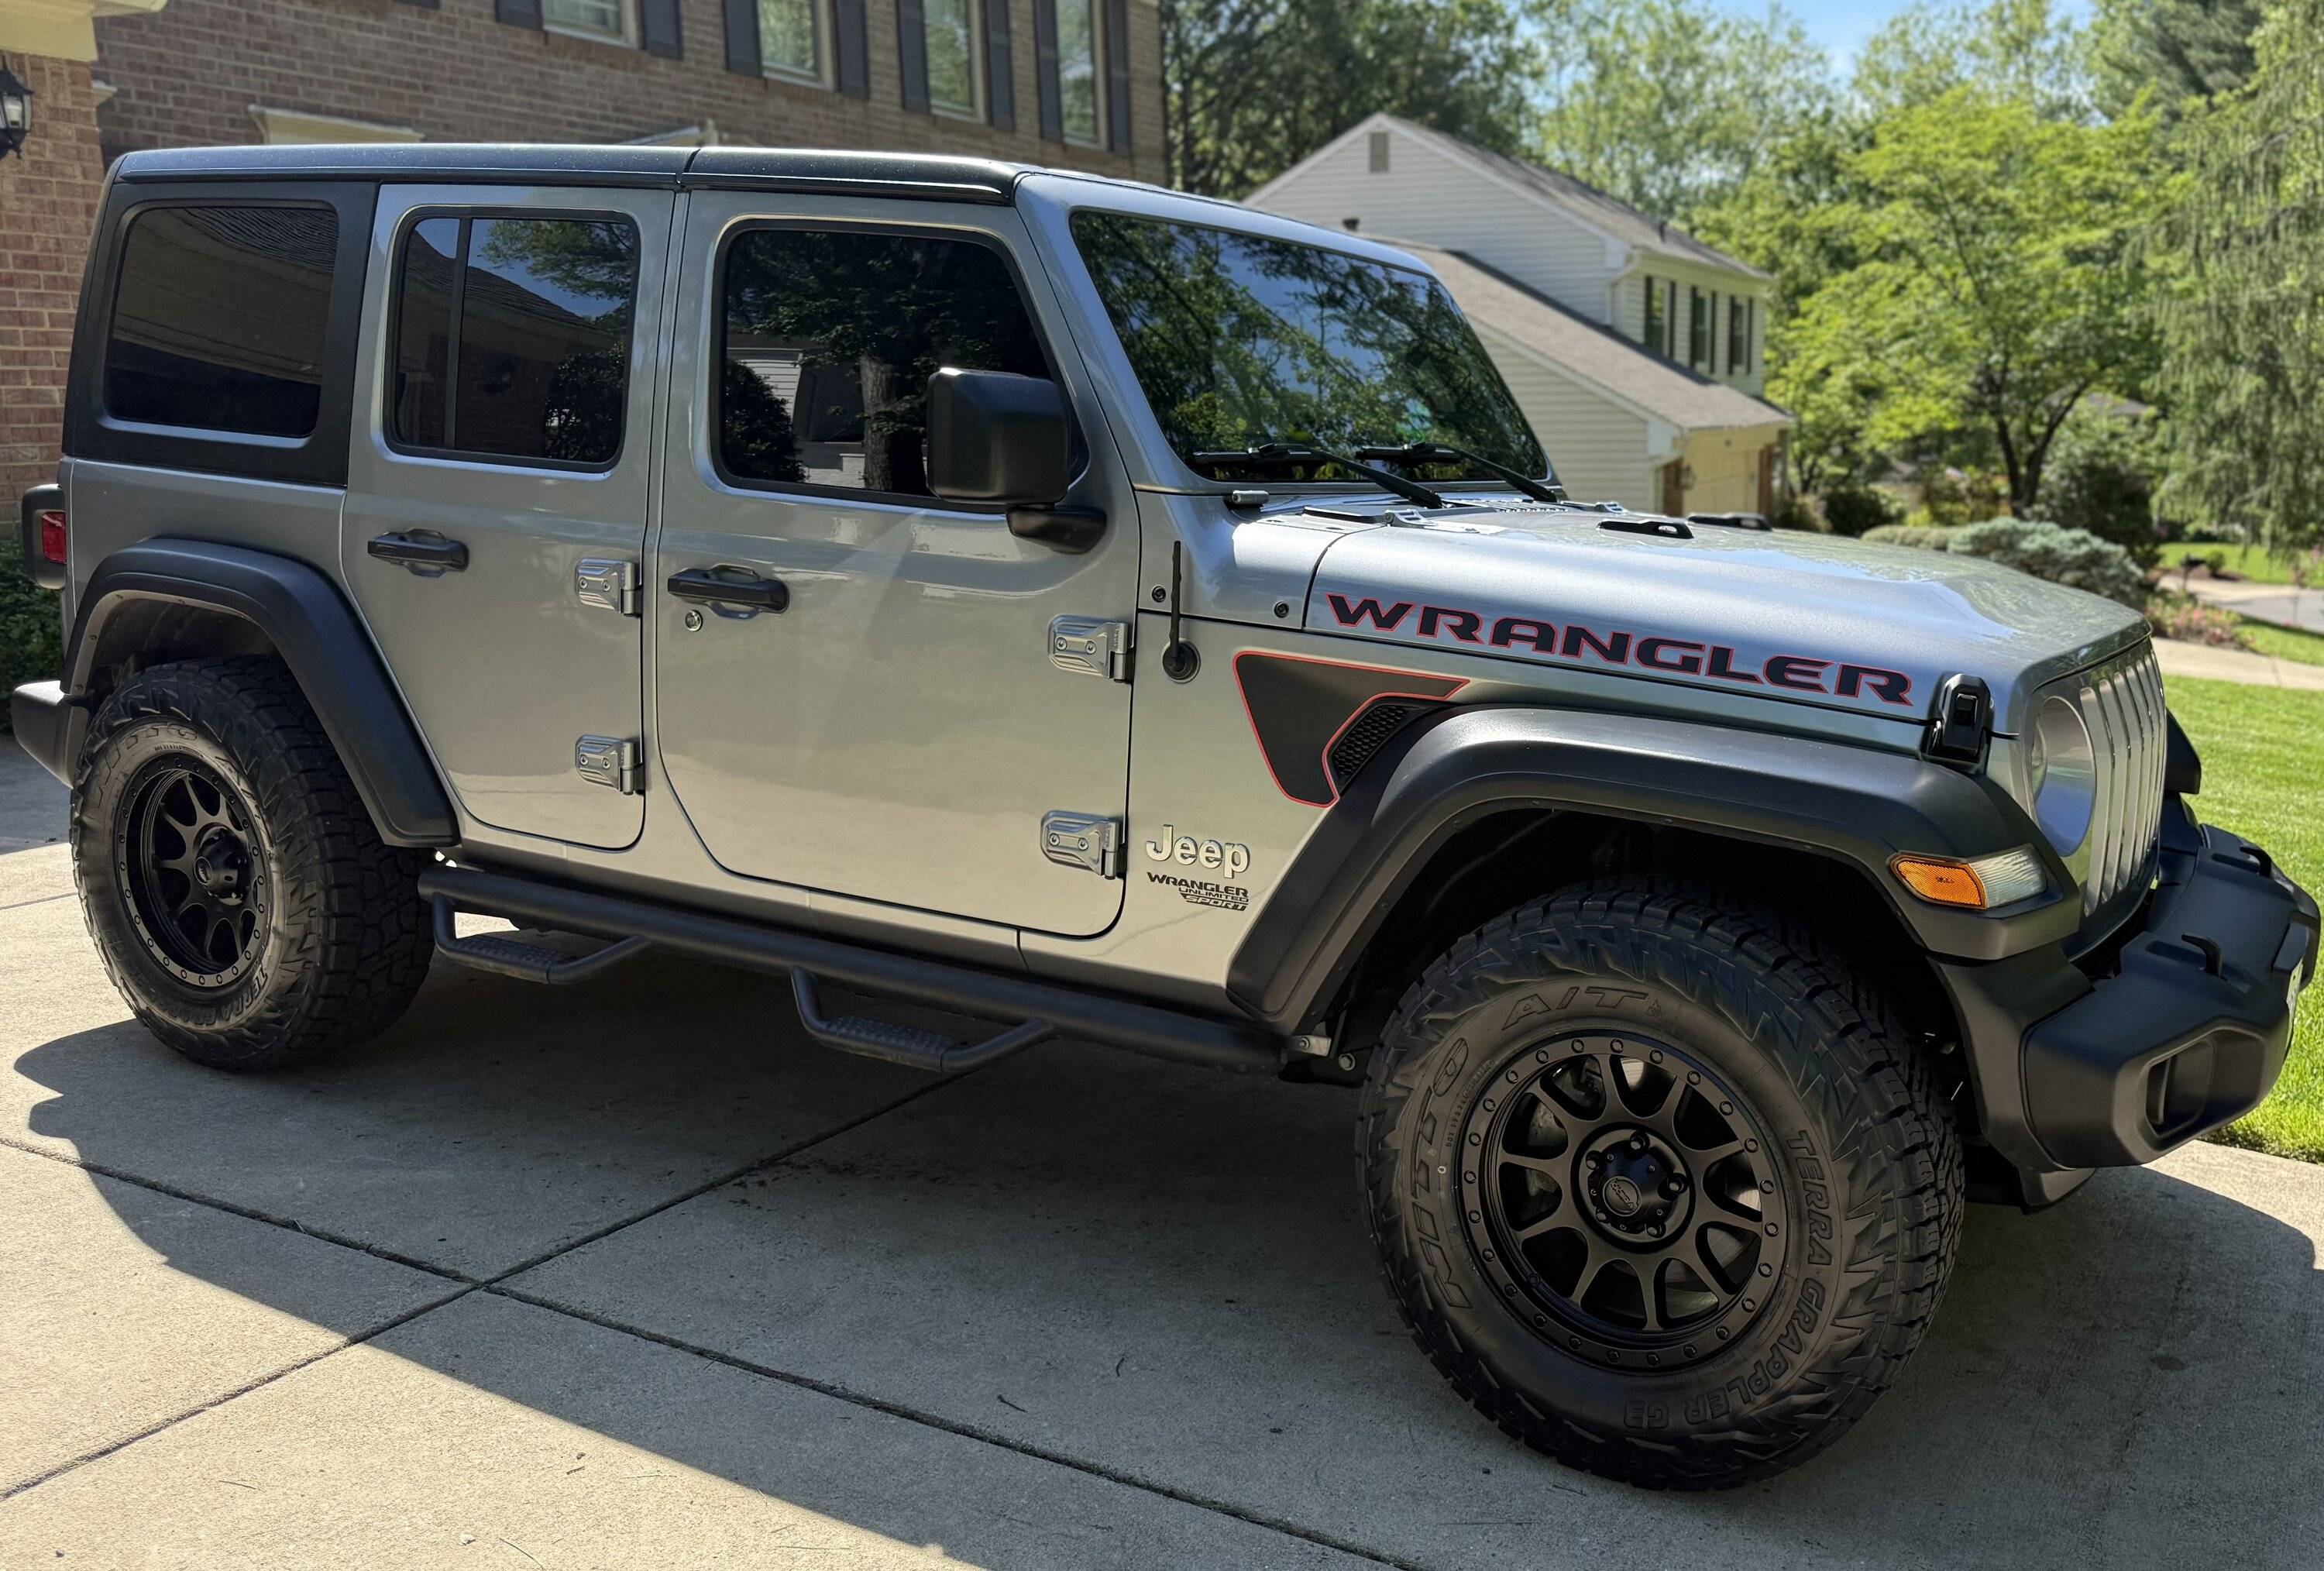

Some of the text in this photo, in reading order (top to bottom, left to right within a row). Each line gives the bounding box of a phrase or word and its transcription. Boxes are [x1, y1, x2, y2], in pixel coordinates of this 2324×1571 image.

[1325, 593, 1913, 706] WRANGLER
[1146, 823, 1250, 878] Jeep
[1147, 871, 1249, 897] WRANGLER
[1179, 888, 1249, 902] UNLIMITED
[1186, 896, 1246, 911] SPORT
[1411, 1038, 1472, 1308] NITTO
[1786, 1129, 1834, 1267] TERRA
[1684, 1278, 1828, 1426] GRAPPLER
